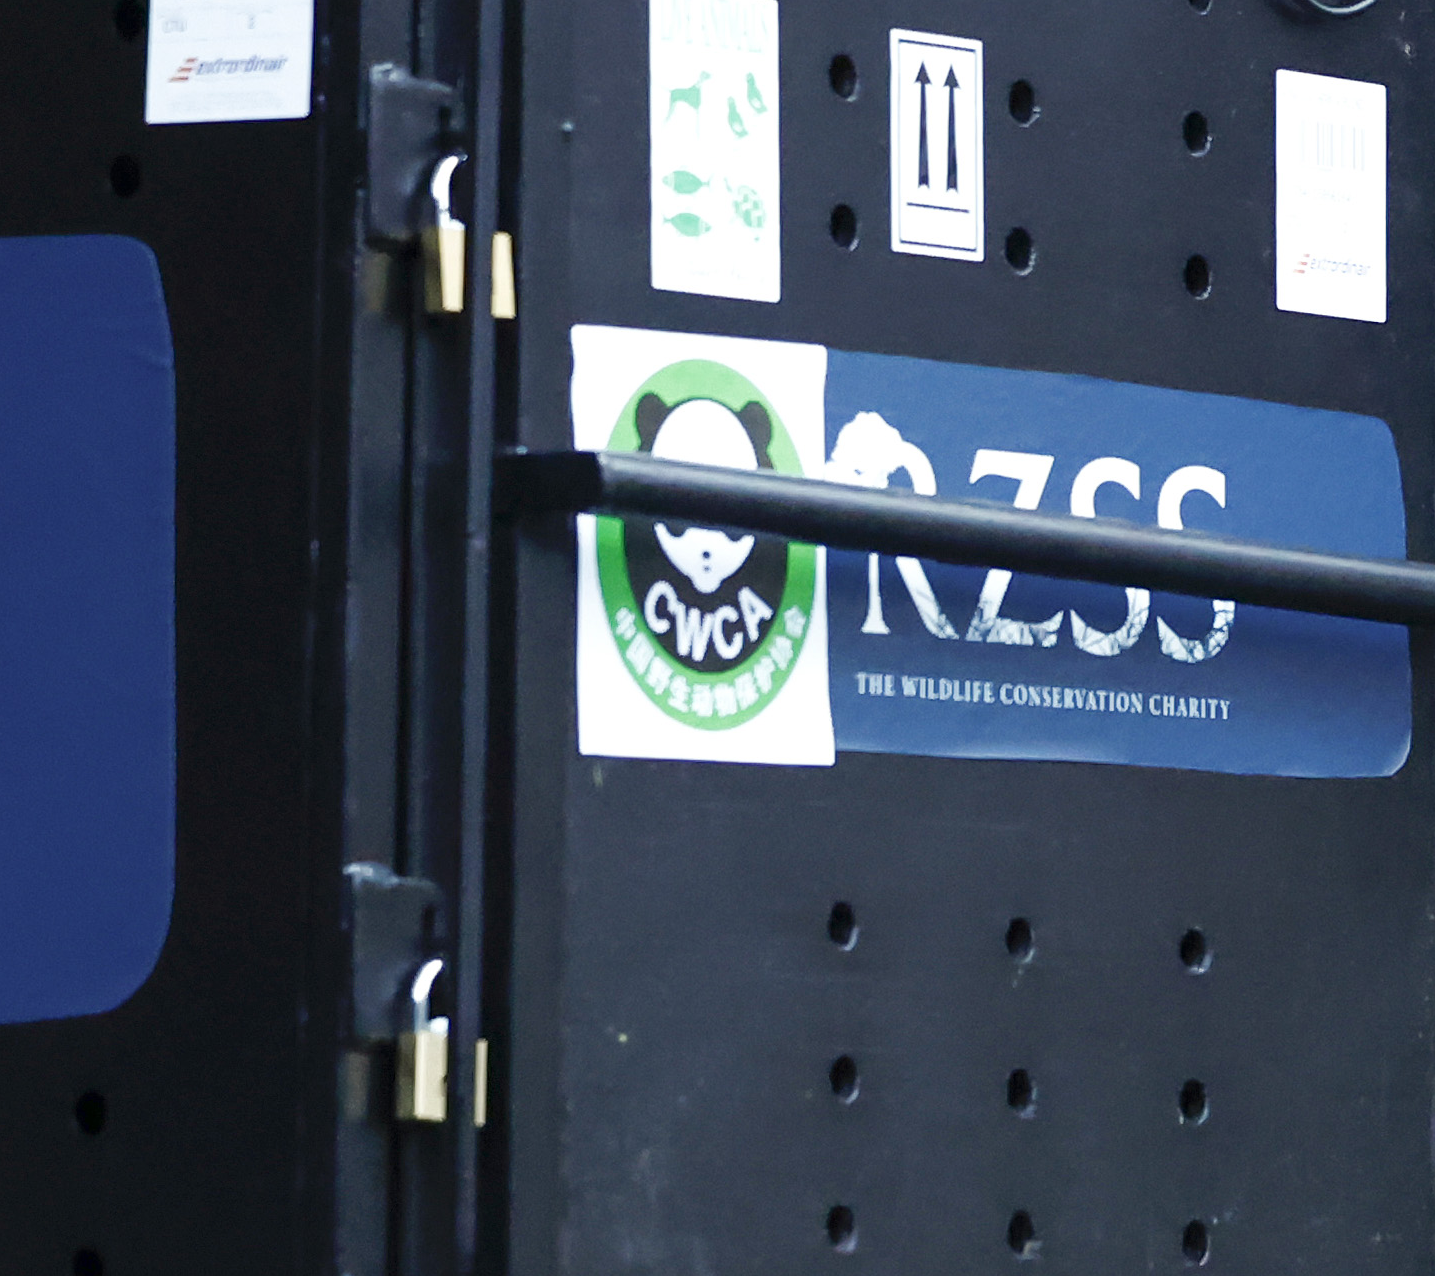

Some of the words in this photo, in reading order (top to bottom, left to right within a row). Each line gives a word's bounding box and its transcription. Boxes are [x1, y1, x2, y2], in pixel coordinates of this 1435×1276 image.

[824, 411, 1236, 663] RZSS
[644, 579, 775, 662] CWCA
[856, 672, 895, 698] THE
[901, 676, 995, 705] WILDLIFE
[999, 683, 1144, 715] CONSERVATION
[1148, 695, 1231, 721] CHARITY
